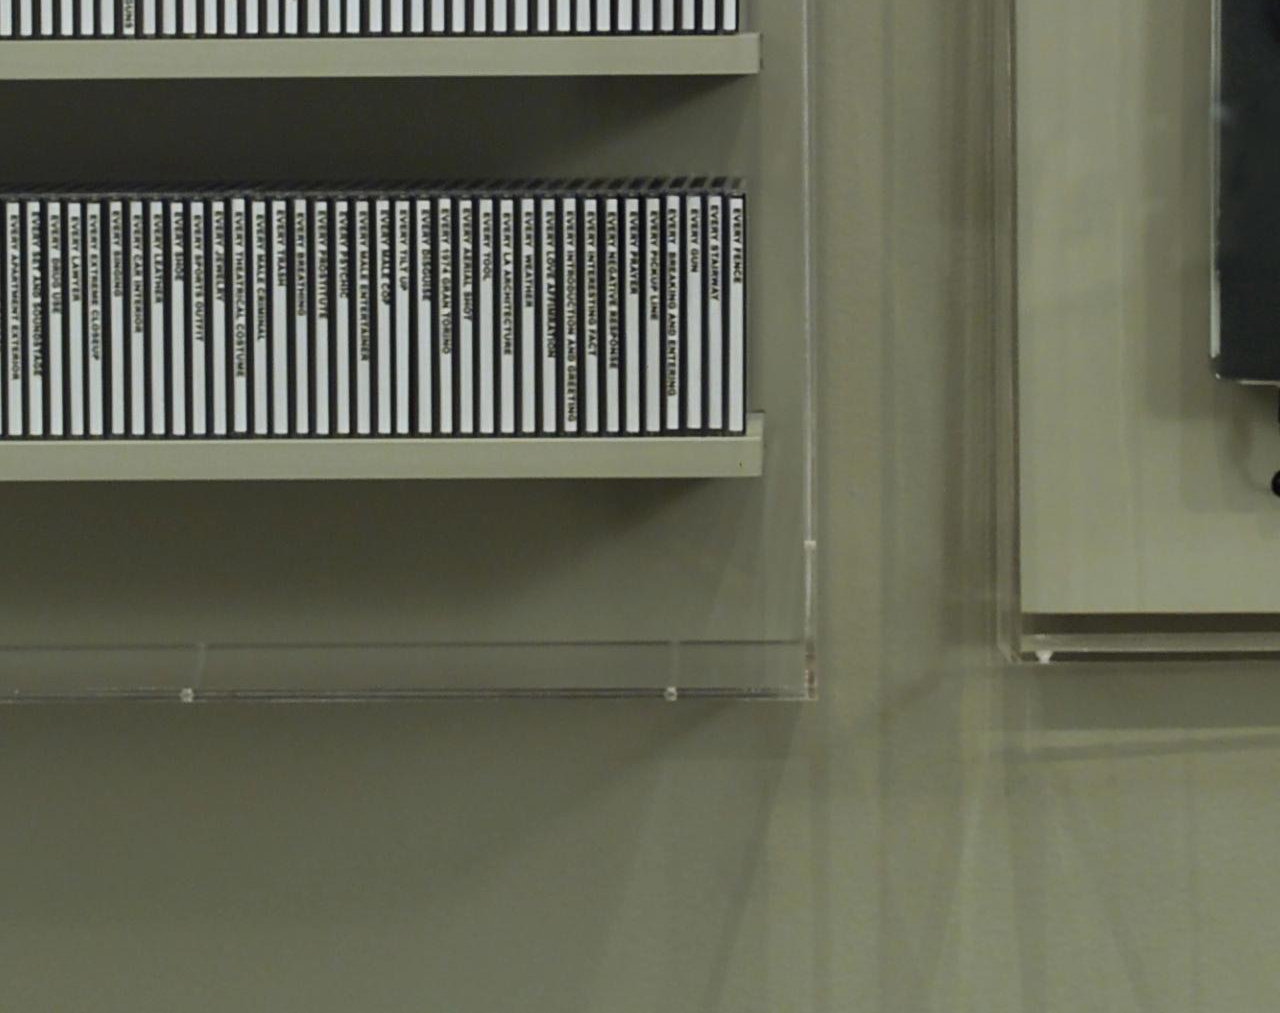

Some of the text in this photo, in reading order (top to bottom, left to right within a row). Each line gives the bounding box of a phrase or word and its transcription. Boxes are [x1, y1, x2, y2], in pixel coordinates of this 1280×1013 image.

[70, 216, 80, 301] EVERY LAWYER
[132, 214, 143, 333] EVERY CAR INTERIOR
[295, 212, 306, 316] EVERY BREATHING
[462, 207, 472, 320] EVERY AERIAL SHOT
[482, 211, 492, 280] EVERY TOOL
[502, 212, 513, 355] EVERY LA ARCHITECTURE
[524, 211, 533, 308] EVERY WEATHER
[586, 210, 597, 356] EVERY INTERESTING FACT
[607, 211, 618, 369] EVERY NEGATIVE RESPONSE
[629, 210, 639, 294] EVERY PRAYER
[649, 210, 659, 320] EVERY PICKUP LINE
[690, 208, 699, 273] EVERY GUN
[709, 204, 719, 300] EVERY STAIRWAY
[733, 207, 742, 283] EVERY FENCE
[666, 208, 677, 396] EVERY BREAKING AND ENTERING
